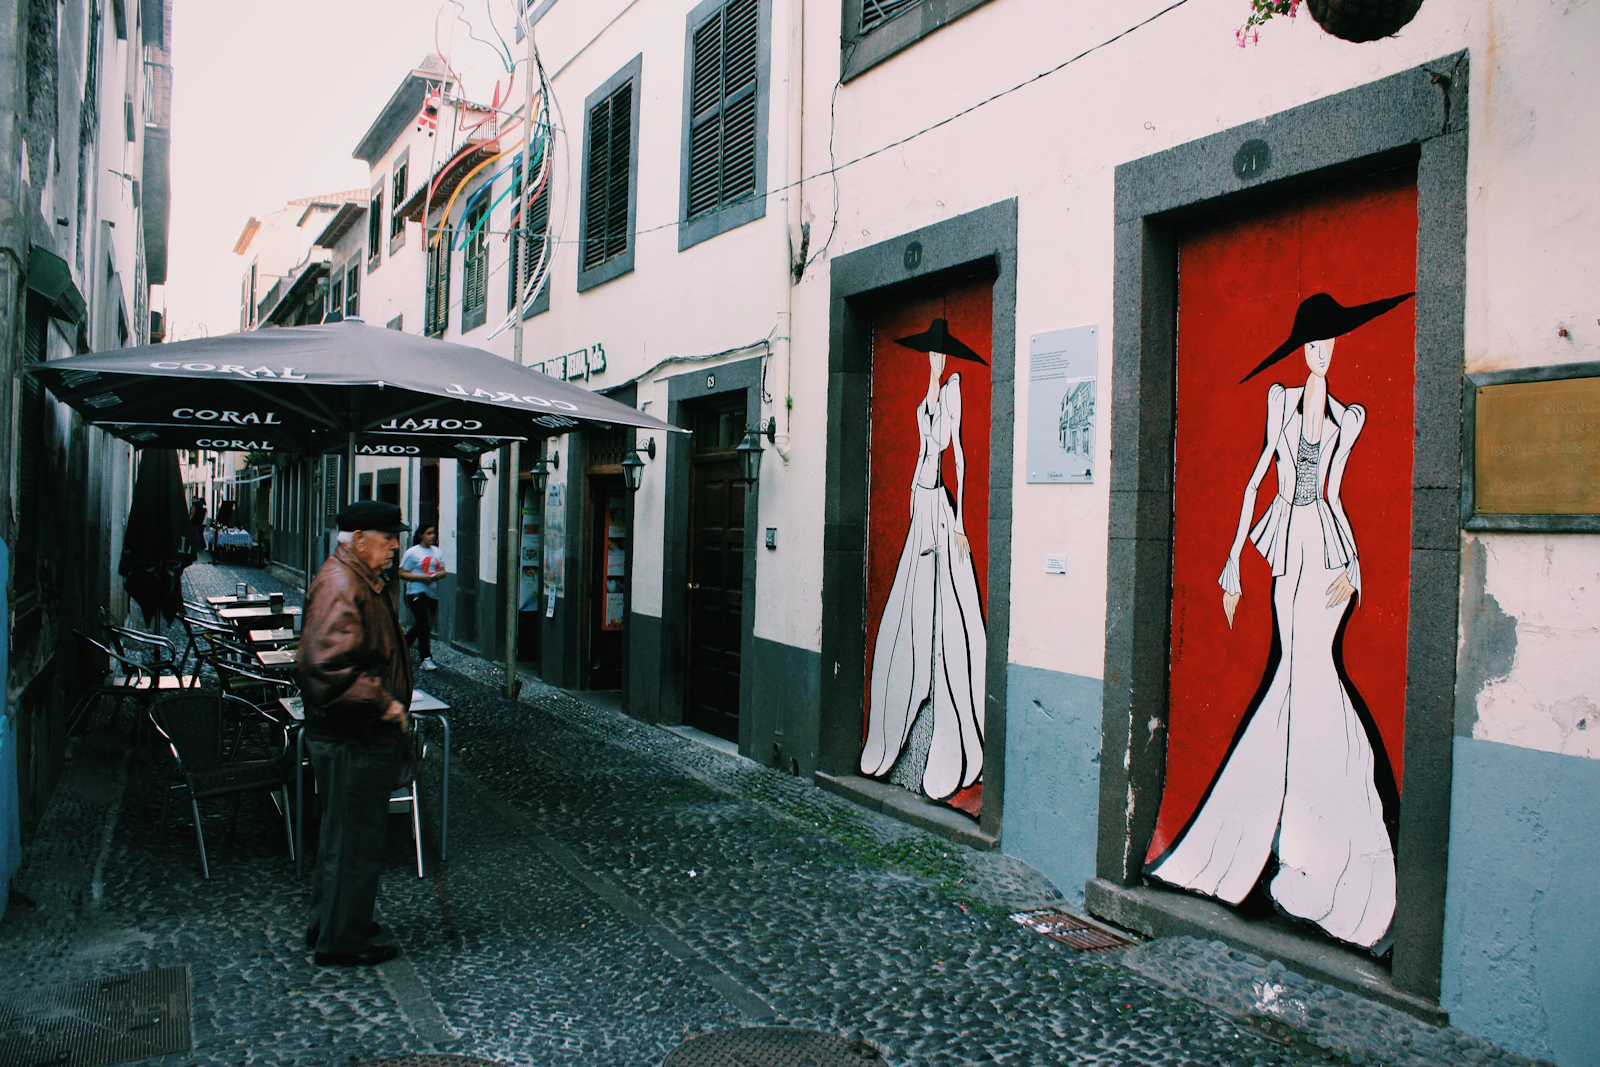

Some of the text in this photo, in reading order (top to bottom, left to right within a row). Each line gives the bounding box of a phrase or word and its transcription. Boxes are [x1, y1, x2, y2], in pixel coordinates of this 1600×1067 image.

[149, 361, 308, 380] CORAL
[171, 408, 282, 425] CORAL
[195, 438, 274, 450] CORAL
